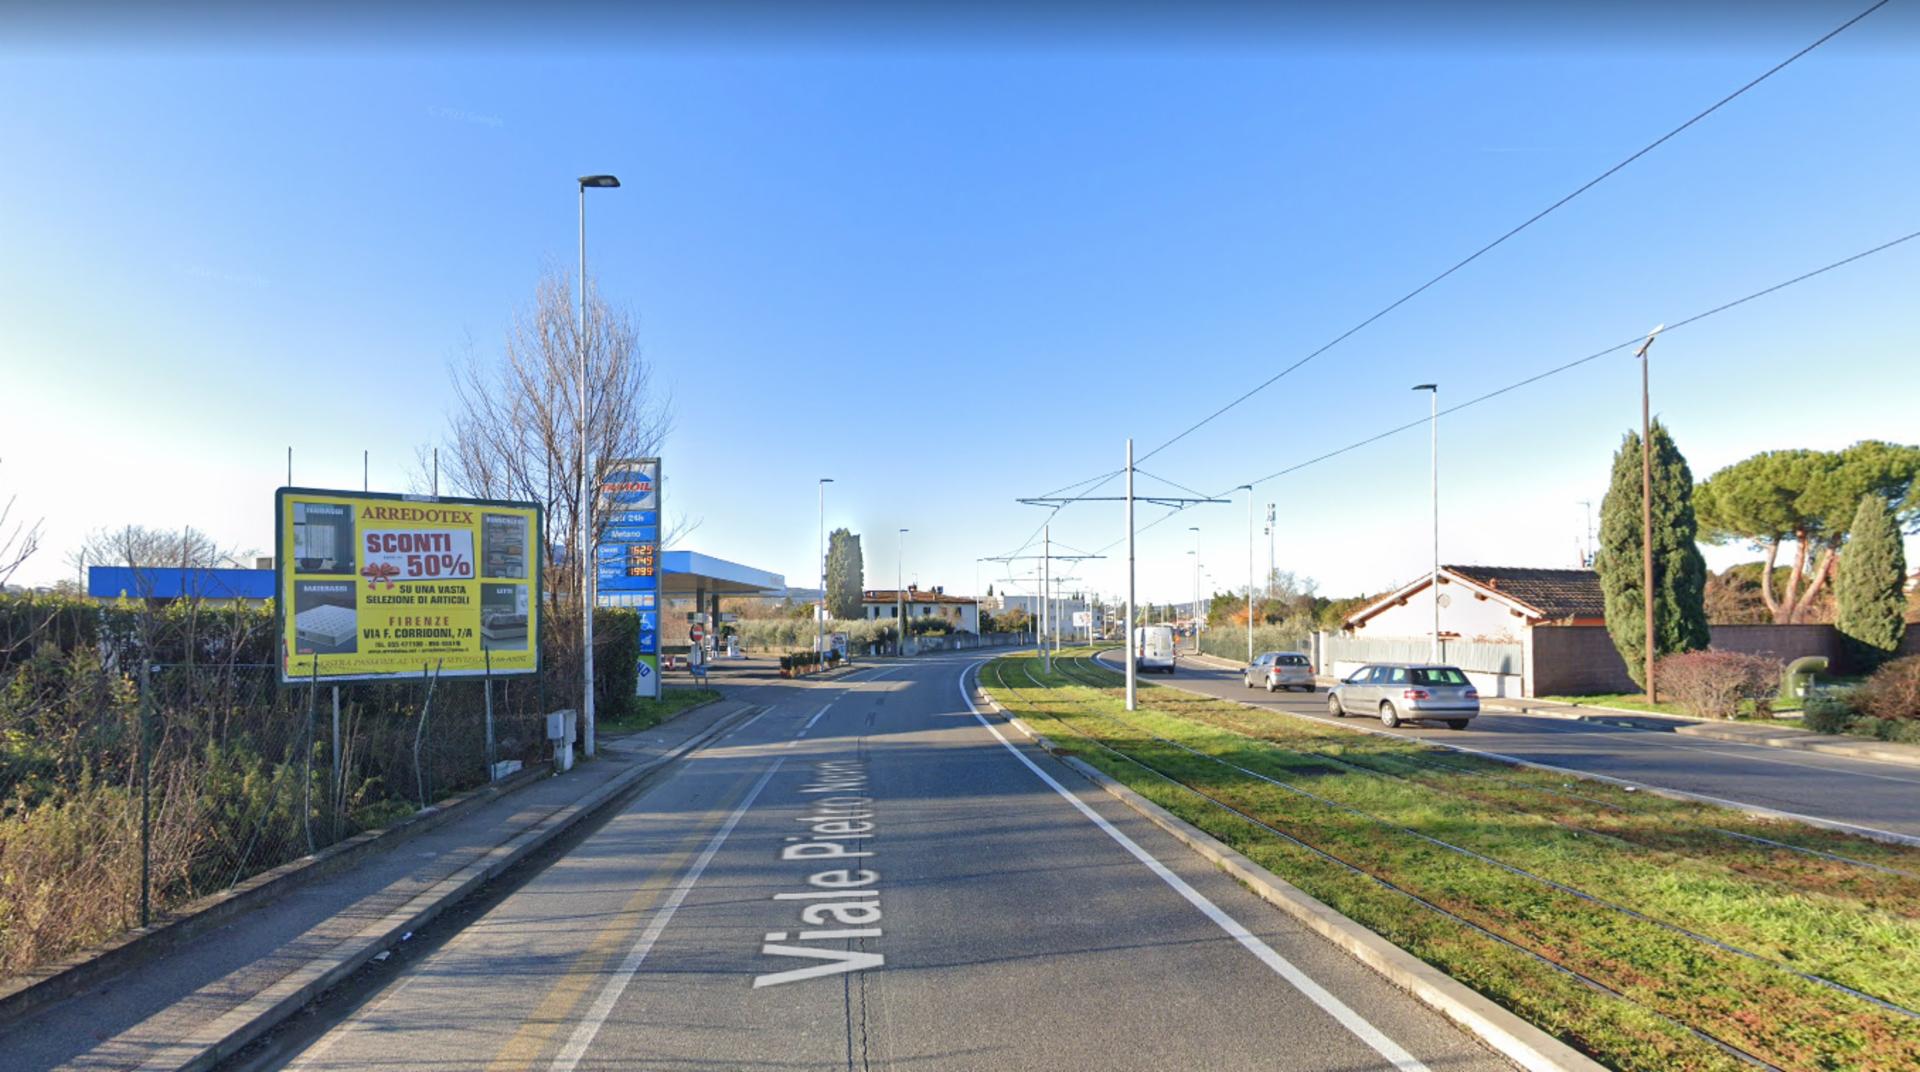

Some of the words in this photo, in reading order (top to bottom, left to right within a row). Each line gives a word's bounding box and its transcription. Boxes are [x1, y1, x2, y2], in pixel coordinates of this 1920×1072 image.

[361, 506, 474, 524] ARREDOTEX
[366, 533, 451, 553] SCONTI
[407, 554, 471, 577] 50%
[400, 585, 412, 594] SU
[415, 585, 436, 594] UNA
[438, 585, 466, 594] VASTA
[366, 595, 415, 604] SELEZIONE
[418, 595, 428, 604] DI
[430, 596, 470, 605] ARTICOLI
[389, 616, 449, 626] FIRENZE
[363, 628, 381, 639] VIA
